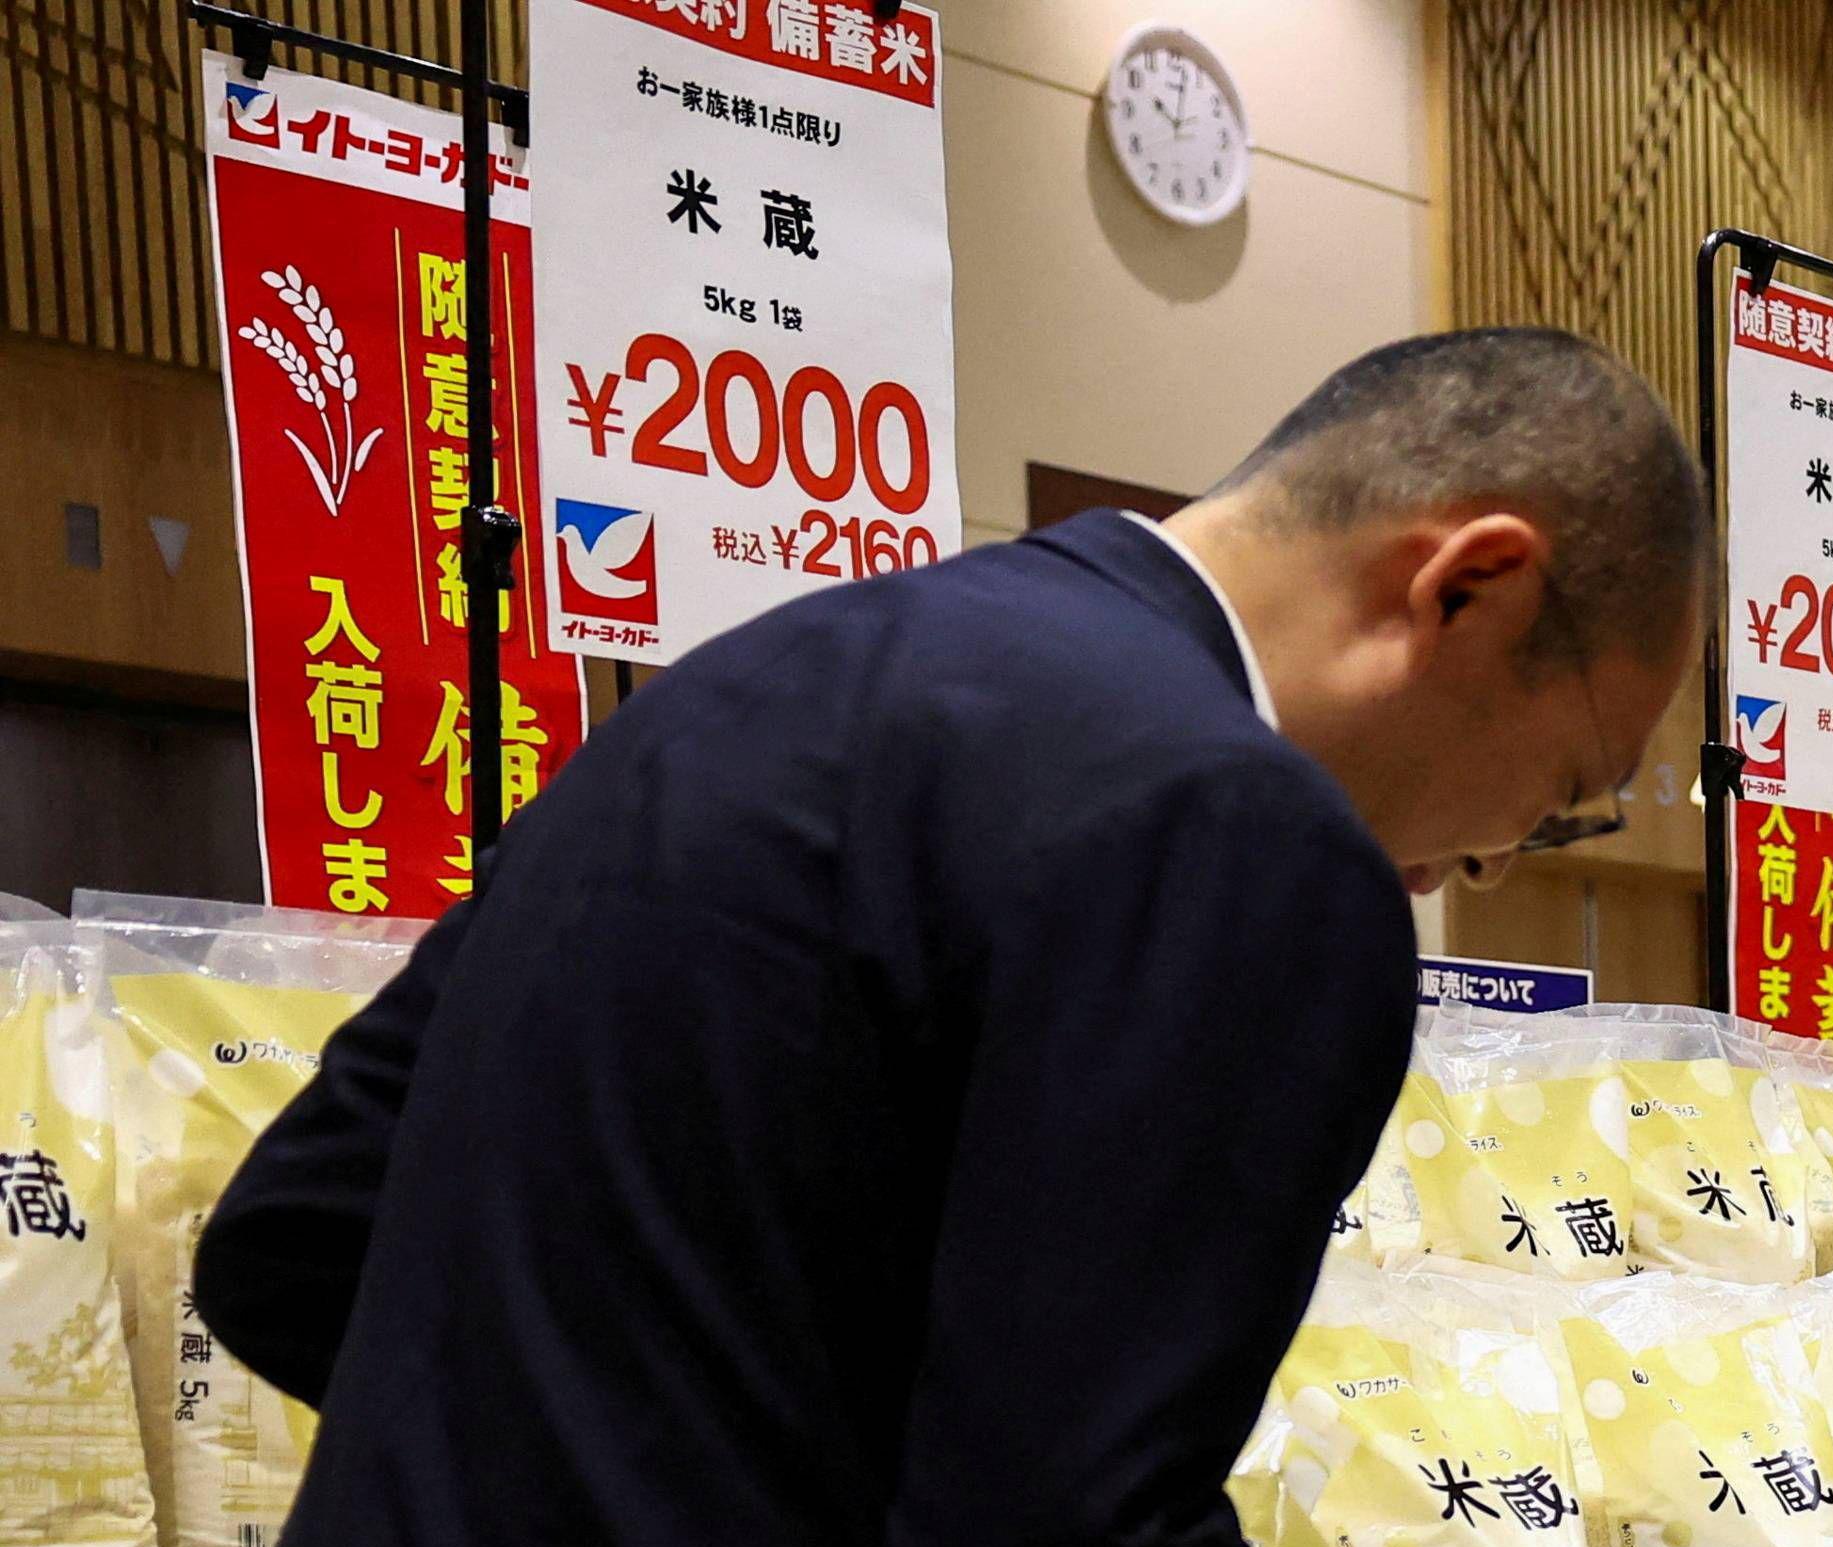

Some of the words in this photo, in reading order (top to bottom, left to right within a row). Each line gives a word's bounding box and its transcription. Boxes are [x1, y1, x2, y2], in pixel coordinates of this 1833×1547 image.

[636, 66, 841, 147] お一家族様1点限り
[703, 285, 757, 323] 5kg
[769, 299, 803, 332] 1袋
[565, 333, 931, 515] ¥2000
[561, 620, 660, 647] イトーヨーカドー
[303, 575, 390, 912] 入荷しま
[1417, 967, 1536, 1006] 販売について
[1417, 1458, 1580, 1531] 米蔵
